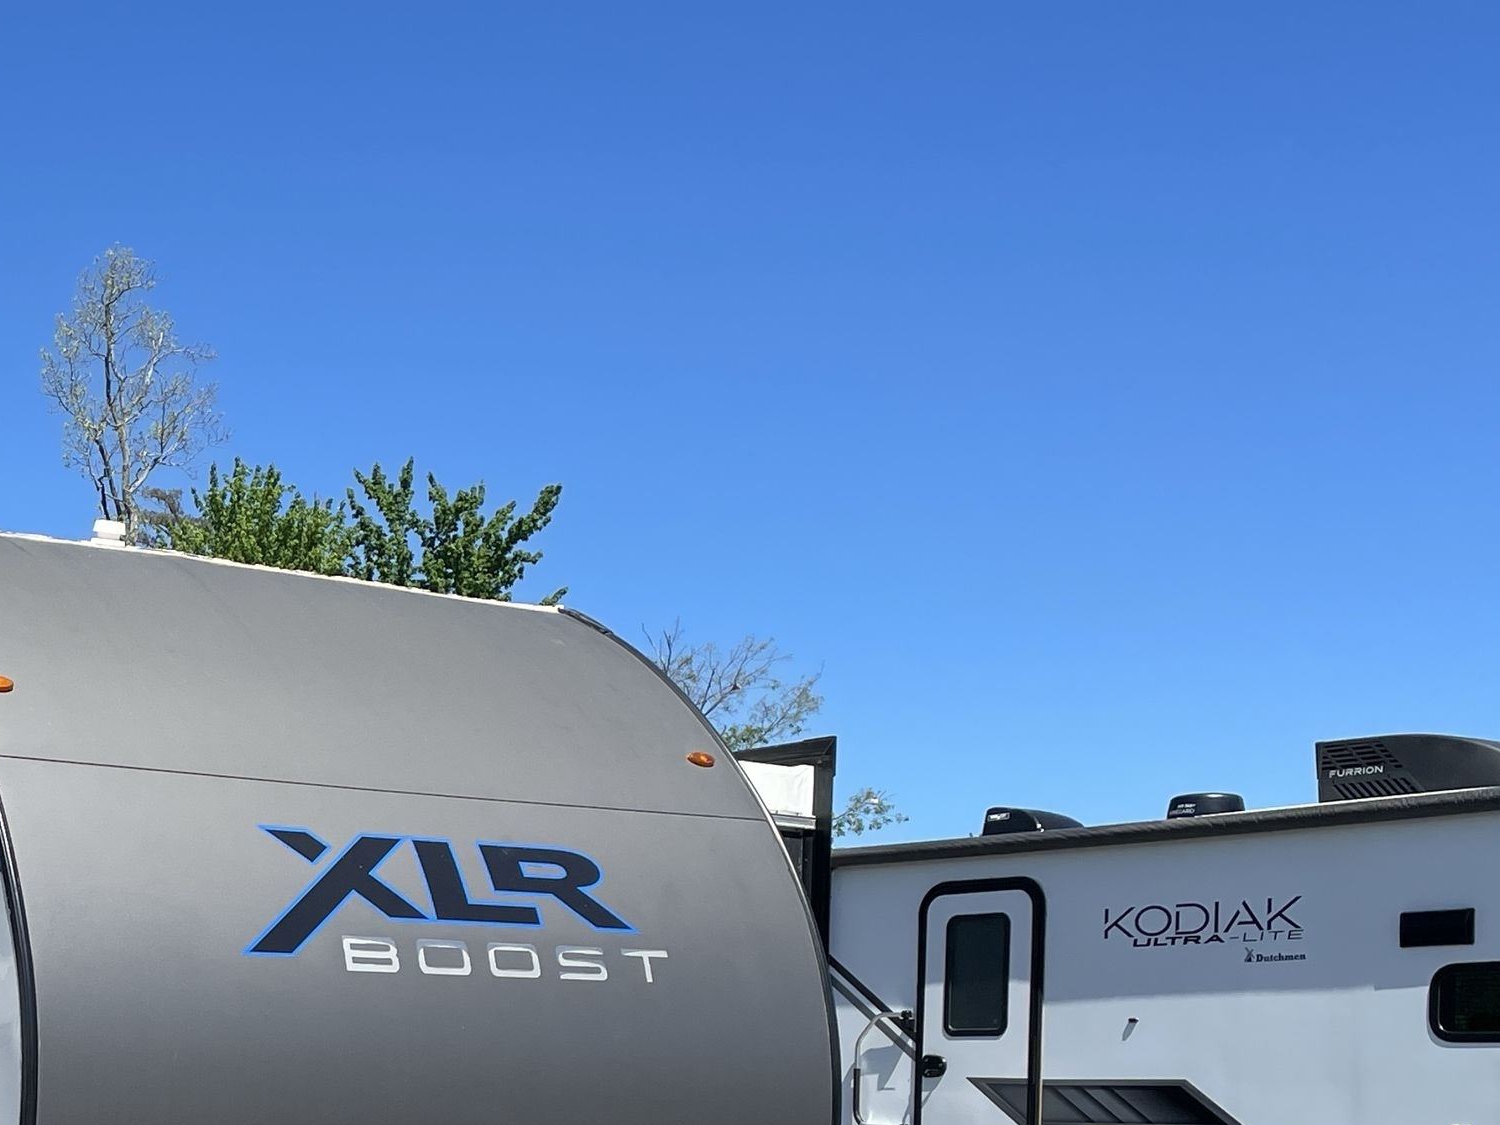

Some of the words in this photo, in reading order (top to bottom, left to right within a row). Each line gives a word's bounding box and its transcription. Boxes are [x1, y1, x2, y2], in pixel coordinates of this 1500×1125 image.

[1328, 764, 1384, 779] FURRION
[243, 823, 639, 956] XLR
[1104, 895, 1303, 940] KODIAK
[1133, 929, 1304, 947] ULTRA-LITE
[341, 936, 669, 983] BOOST
[1255, 951, 1306, 963] Dutchmen
